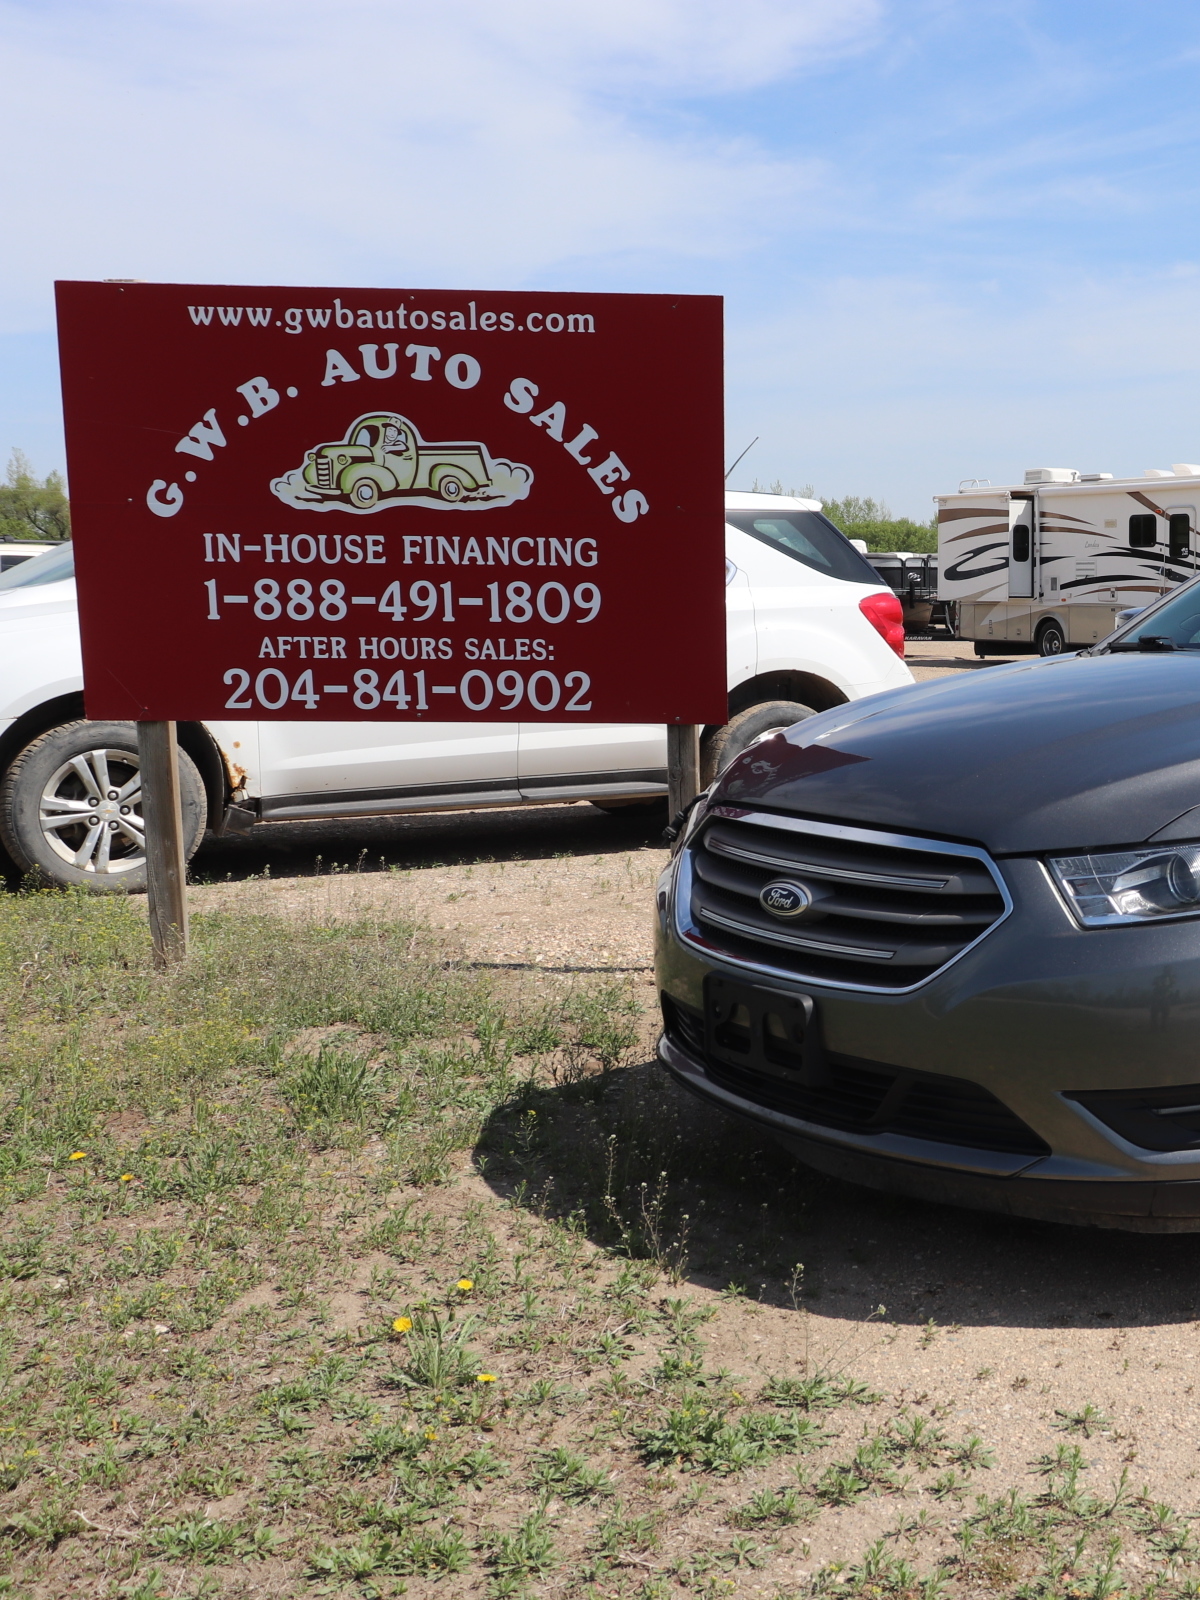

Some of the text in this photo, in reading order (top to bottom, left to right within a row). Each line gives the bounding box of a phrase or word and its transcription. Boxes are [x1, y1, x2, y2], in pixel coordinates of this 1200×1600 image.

[187, 298, 596, 335] www.gwbautosales.com
[146, 342, 650, 524] G.W.B. AUTO SALES
[202, 532, 599, 568] IN-HOUSE FINANCING
[203, 578, 602, 624] 1-888-491-1809
[257, 636, 556, 662] AFTER HOURS SALES:
[223, 667, 593, 712] 204-841-0902
[767, 888, 794, 909] Ford
